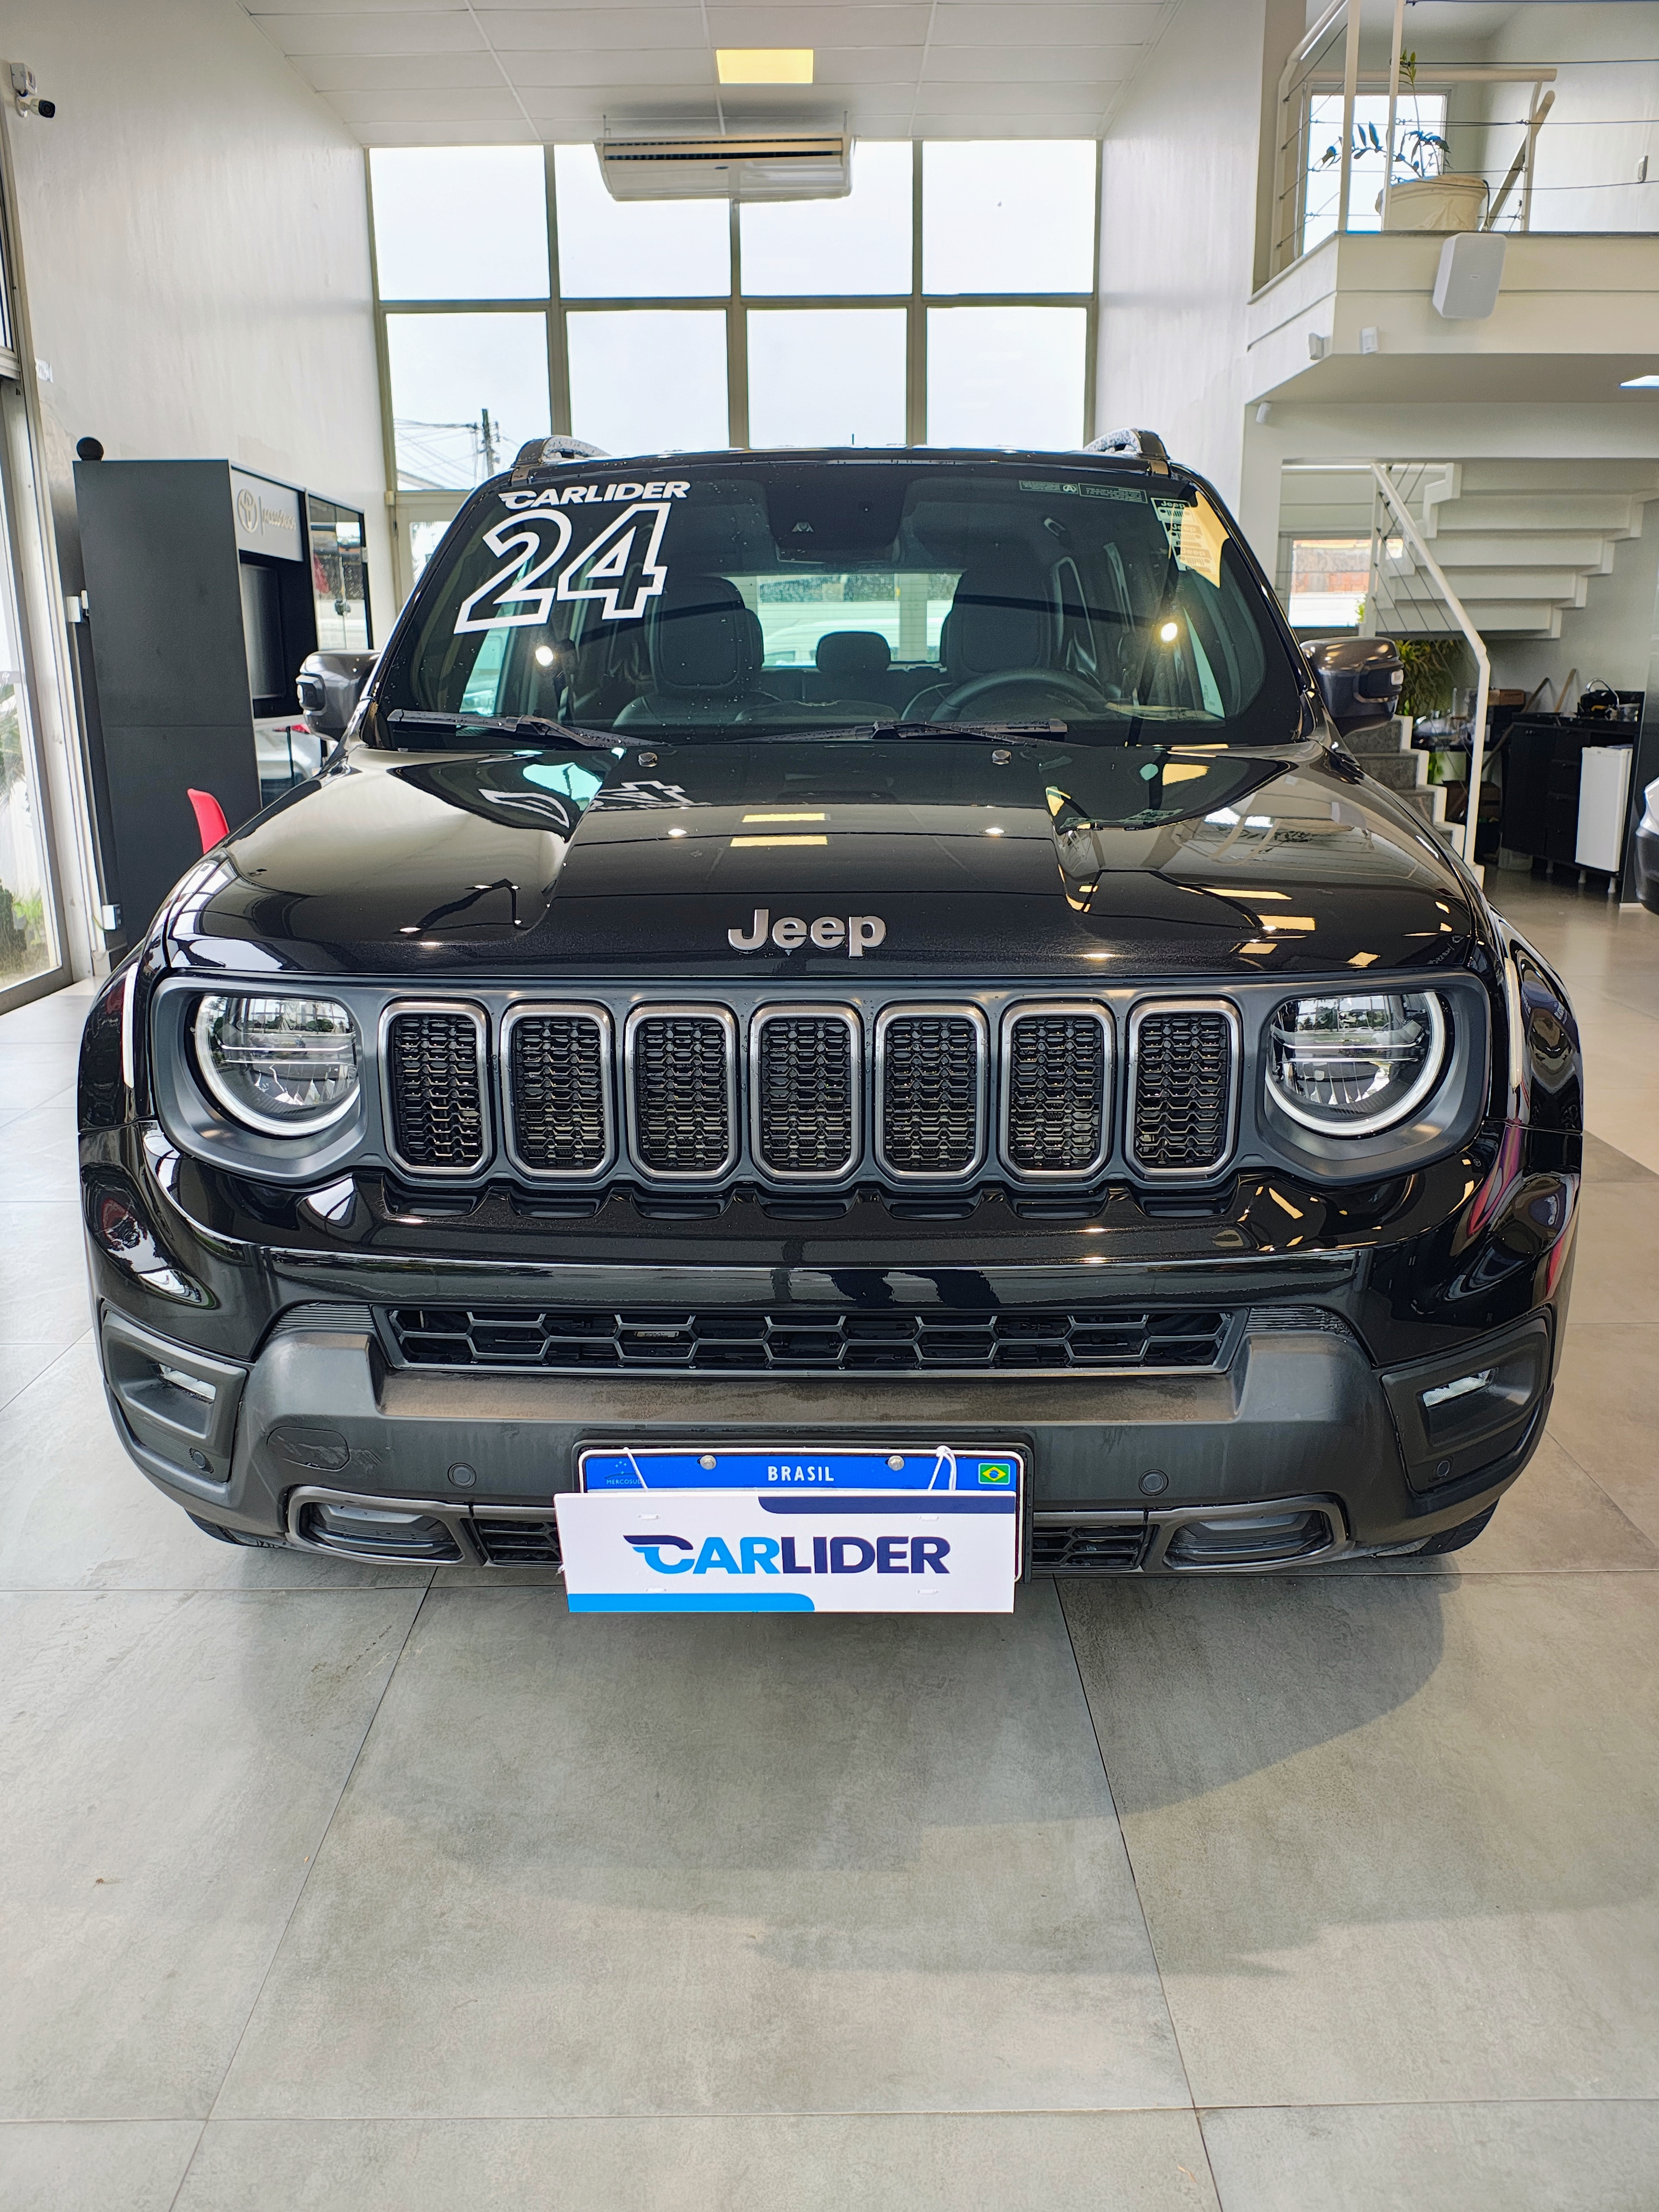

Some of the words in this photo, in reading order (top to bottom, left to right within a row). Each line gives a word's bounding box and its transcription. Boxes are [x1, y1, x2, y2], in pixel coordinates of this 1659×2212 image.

[498, 481, 691, 510] CARLIDER
[1161, 500, 1186, 509] Jeep
[454, 502, 671, 635] 24
[727, 909, 887, 960] Jeep
[767, 1465, 835, 1482] BRASIL
[623, 1534, 951, 1575] CARLIDER
